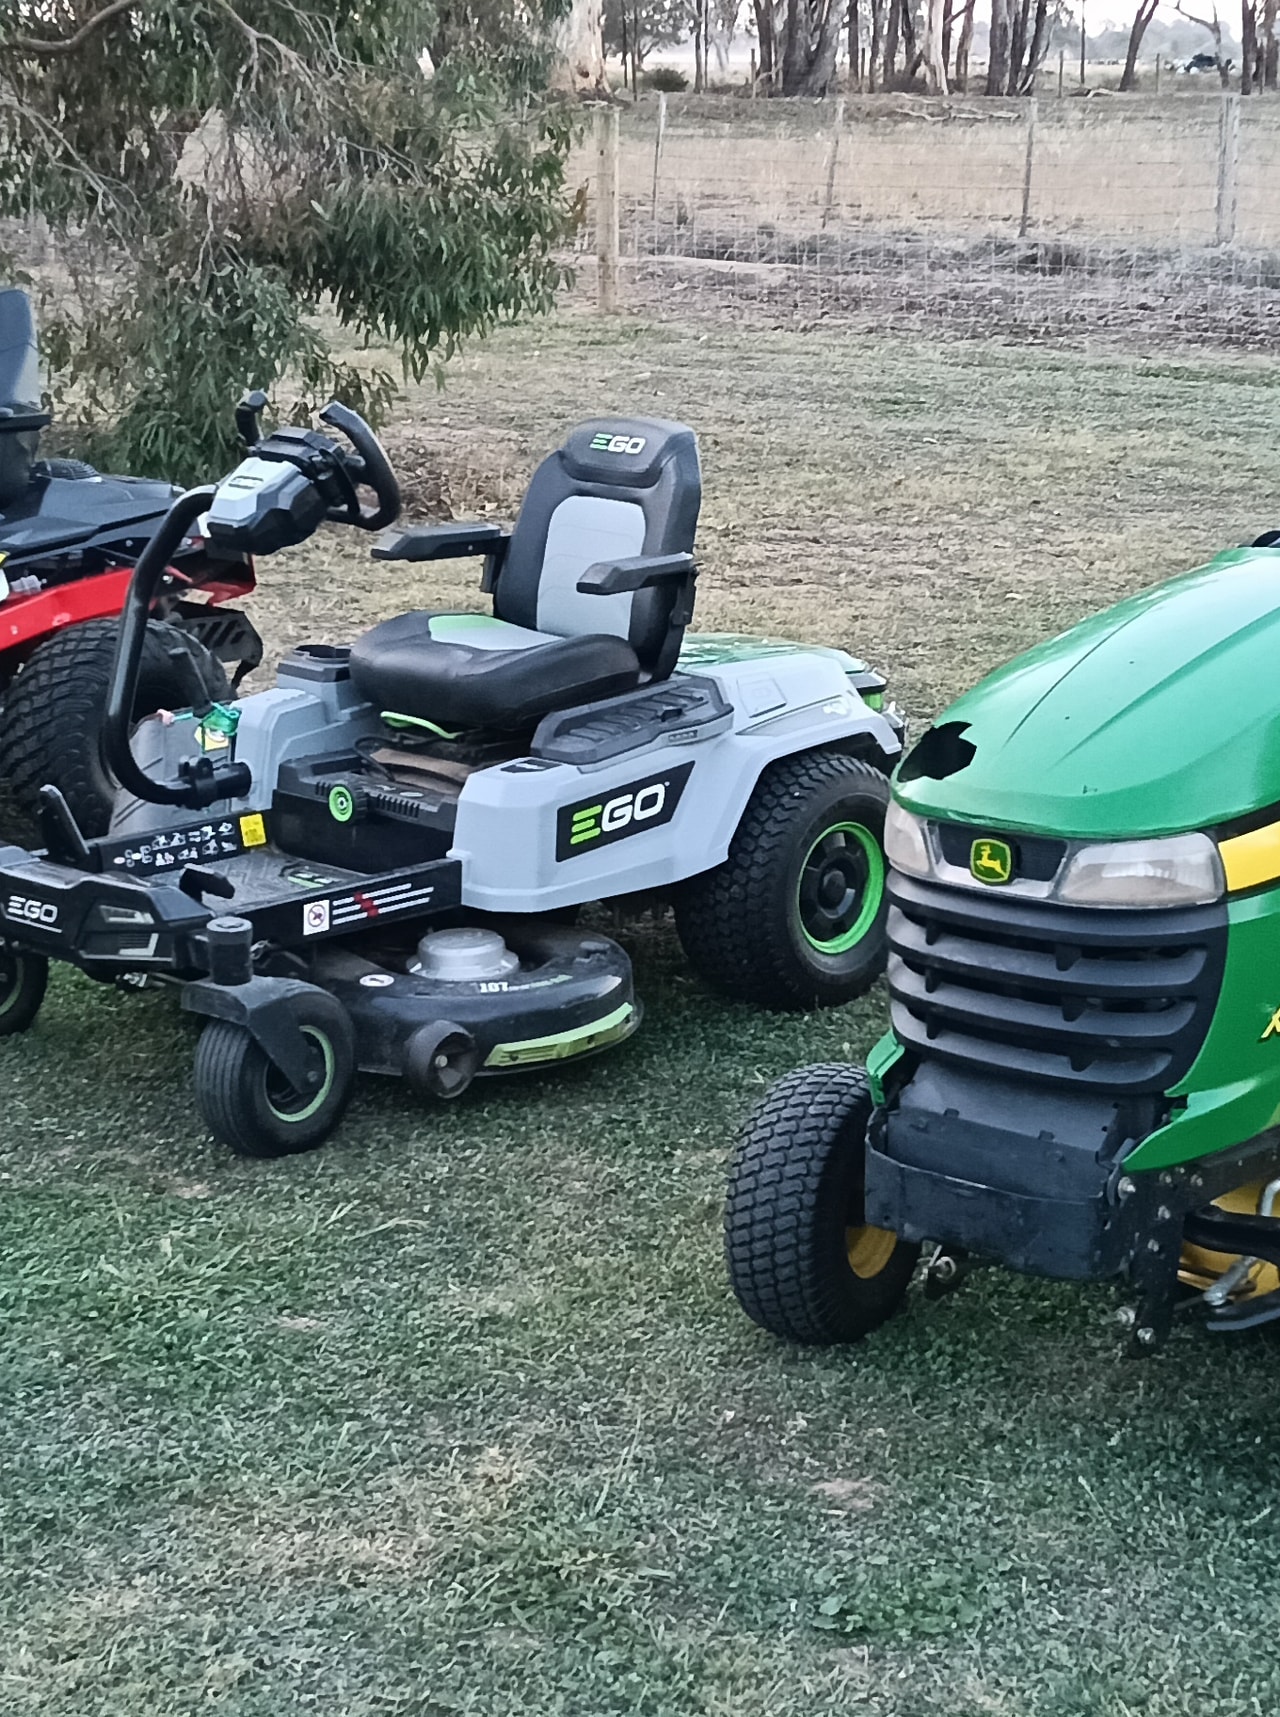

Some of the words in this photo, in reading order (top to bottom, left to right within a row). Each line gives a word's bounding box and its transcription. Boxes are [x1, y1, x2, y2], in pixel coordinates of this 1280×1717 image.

[590, 433, 646, 454] EGO
[570, 783, 665, 845] EGO
[7, 895, 58, 923] EGO
